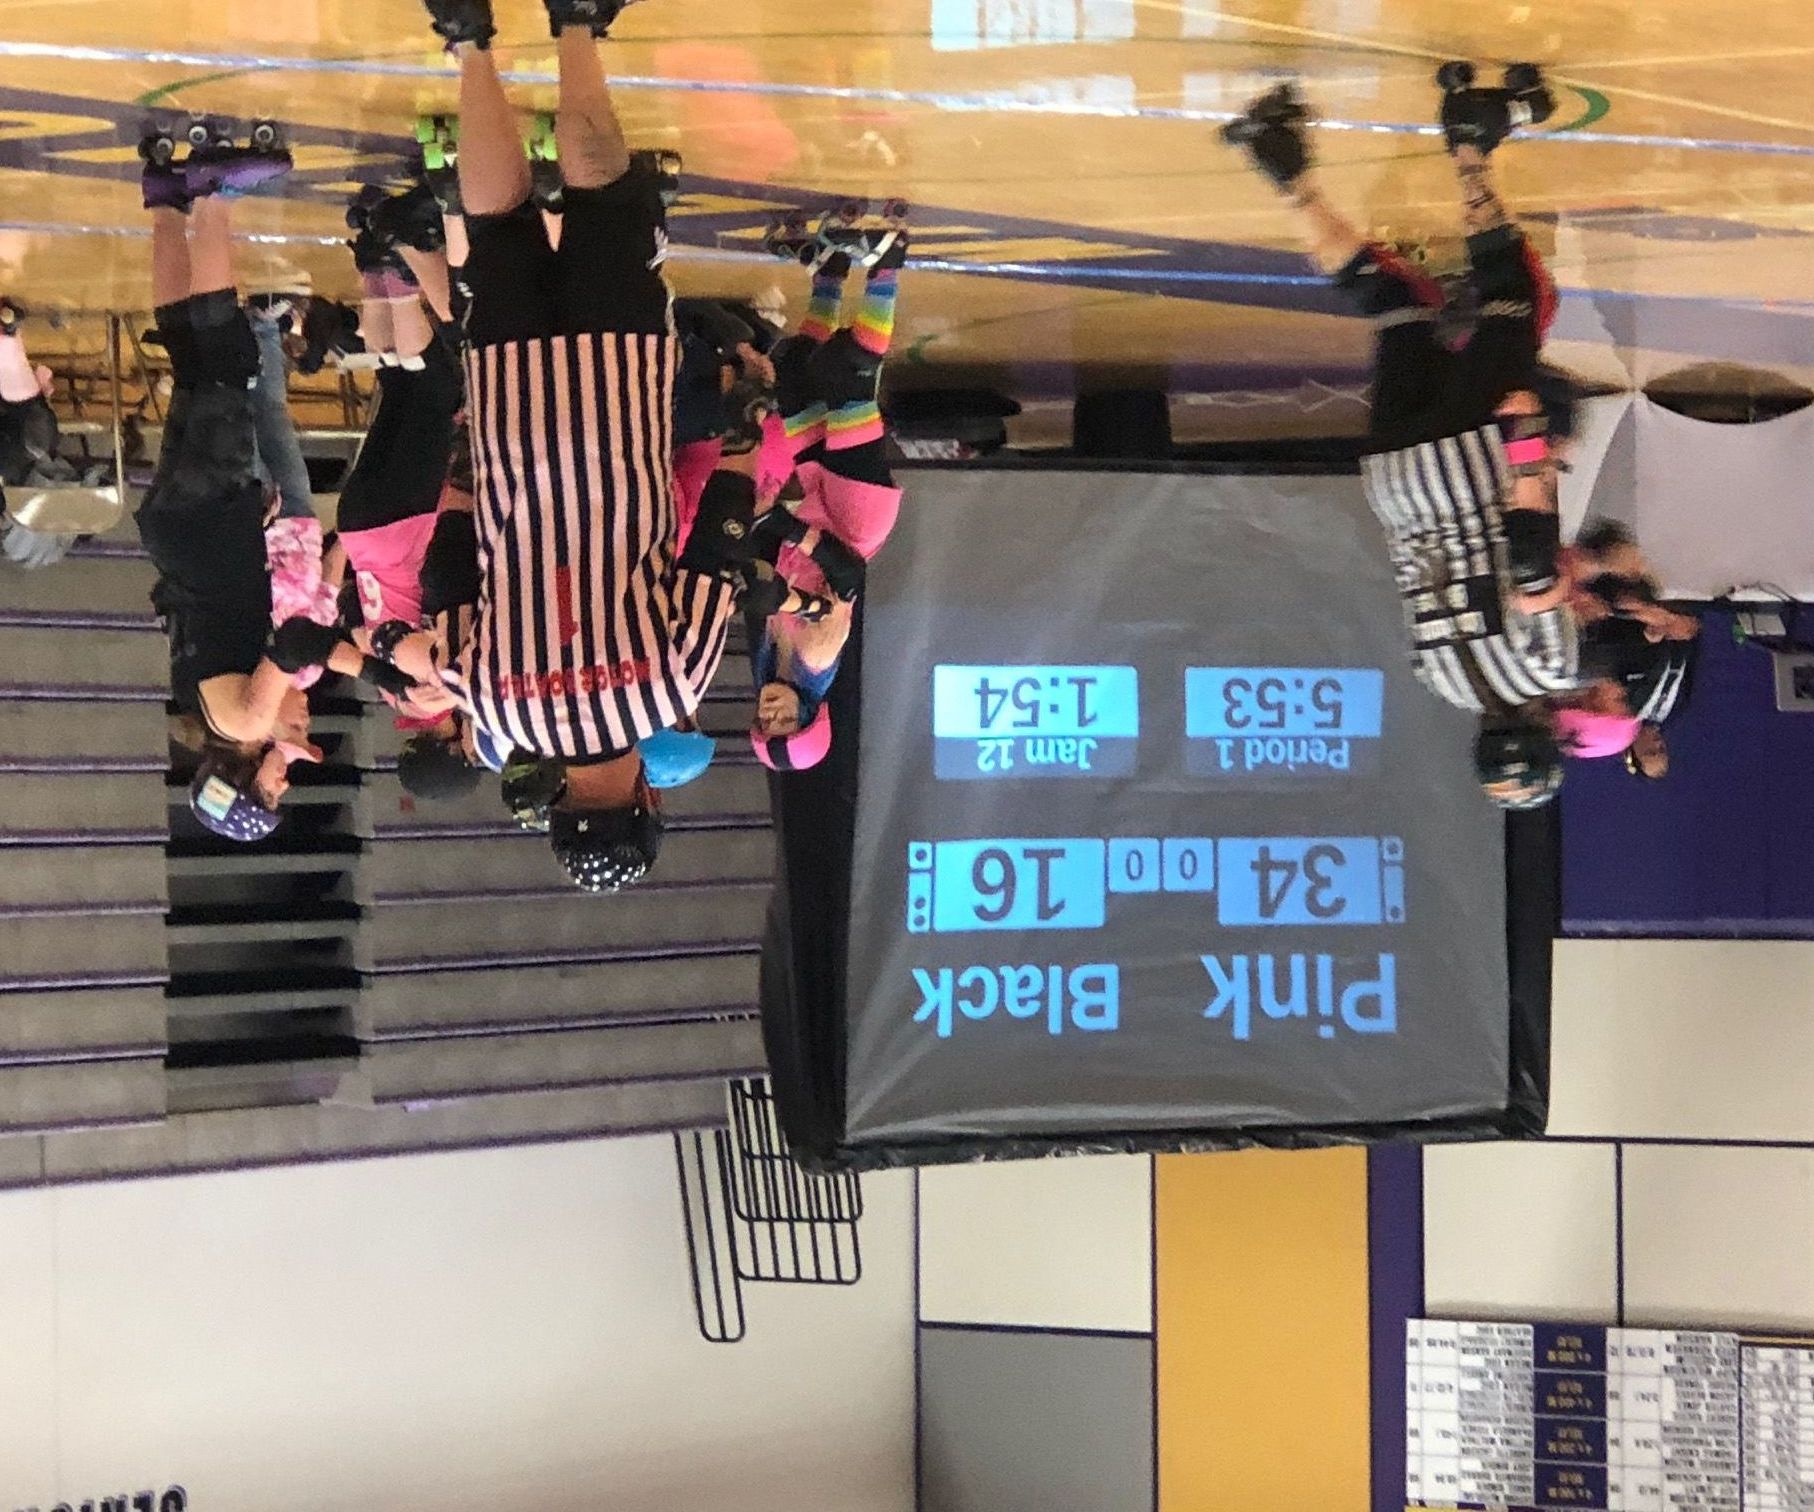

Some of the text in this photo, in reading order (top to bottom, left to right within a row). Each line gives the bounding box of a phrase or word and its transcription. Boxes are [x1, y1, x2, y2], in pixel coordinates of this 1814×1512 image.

[556, 565, 578, 646] 1
[974, 676, 1098, 729] 1:54
[1223, 678, 1343, 729] 5:53
[977, 738, 1097, 771] Jam 12
[1216, 738, 1350, 770] Period 1
[971, 847, 1067, 923] 16
[1250, 844, 1347, 923] 34
[911, 963, 1120, 1038] Black
[1200, 952, 1398, 1040] Pink
